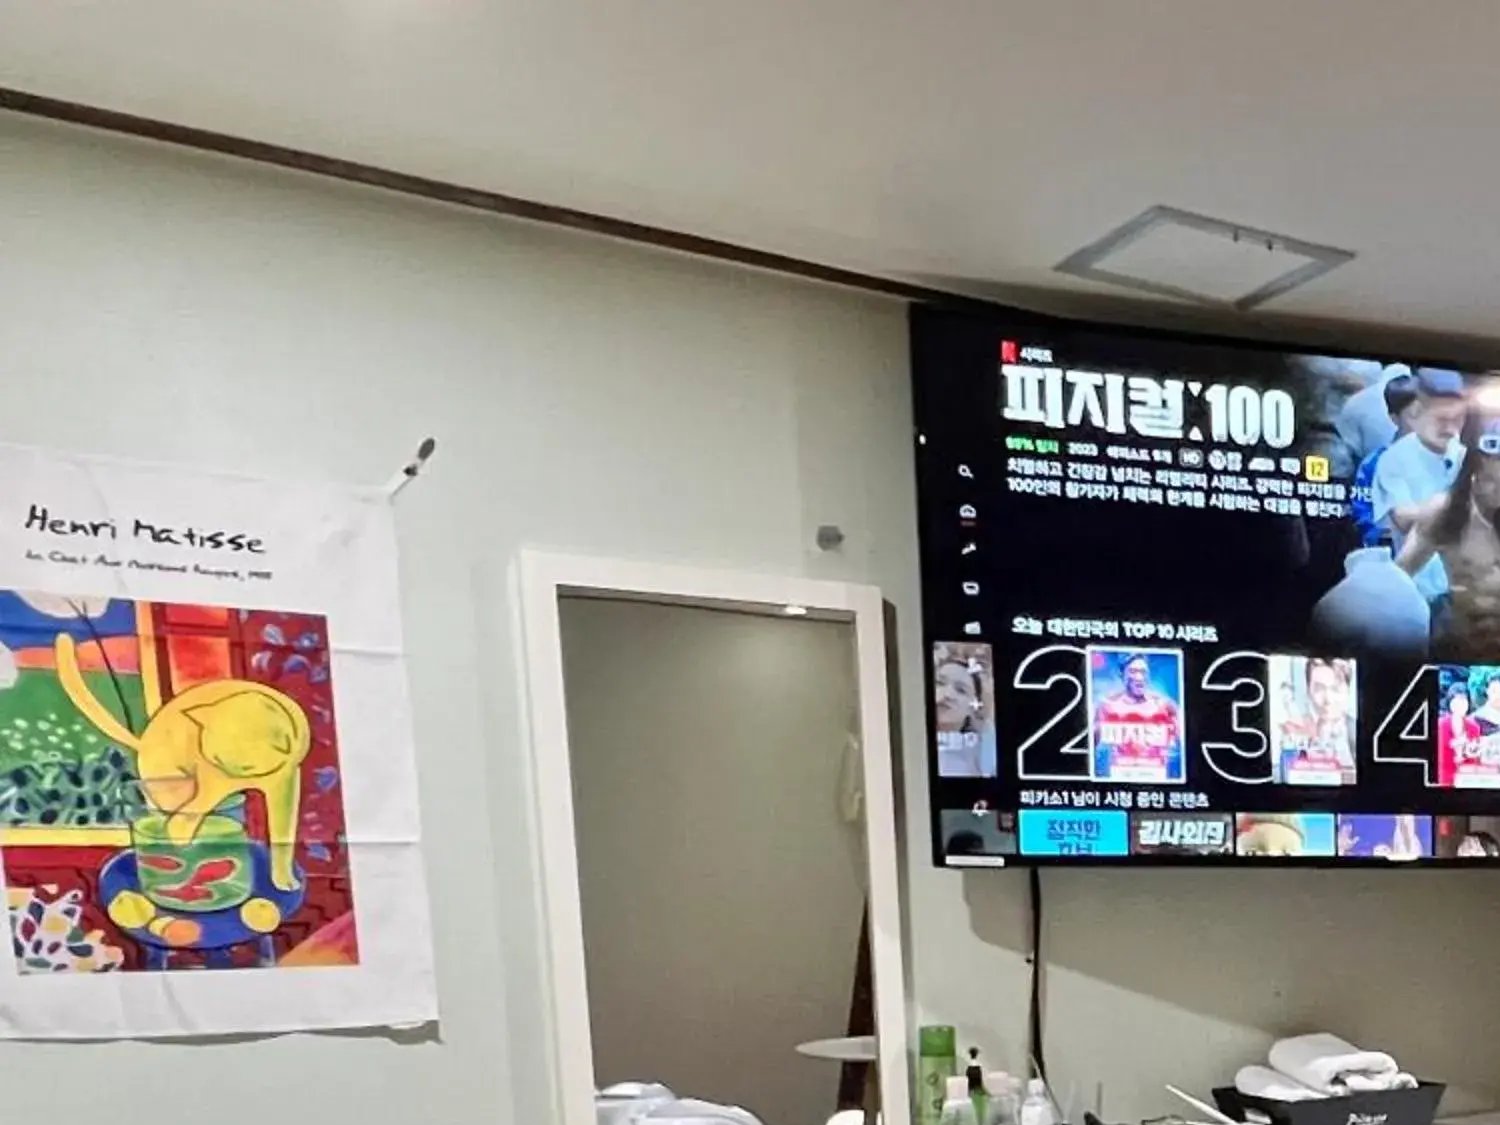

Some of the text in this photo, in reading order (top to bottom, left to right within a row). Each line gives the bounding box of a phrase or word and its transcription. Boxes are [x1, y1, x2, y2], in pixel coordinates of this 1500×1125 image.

[24, 503, 267, 554] Henri Matisse
[1122, 622, 1157, 639] TOP
